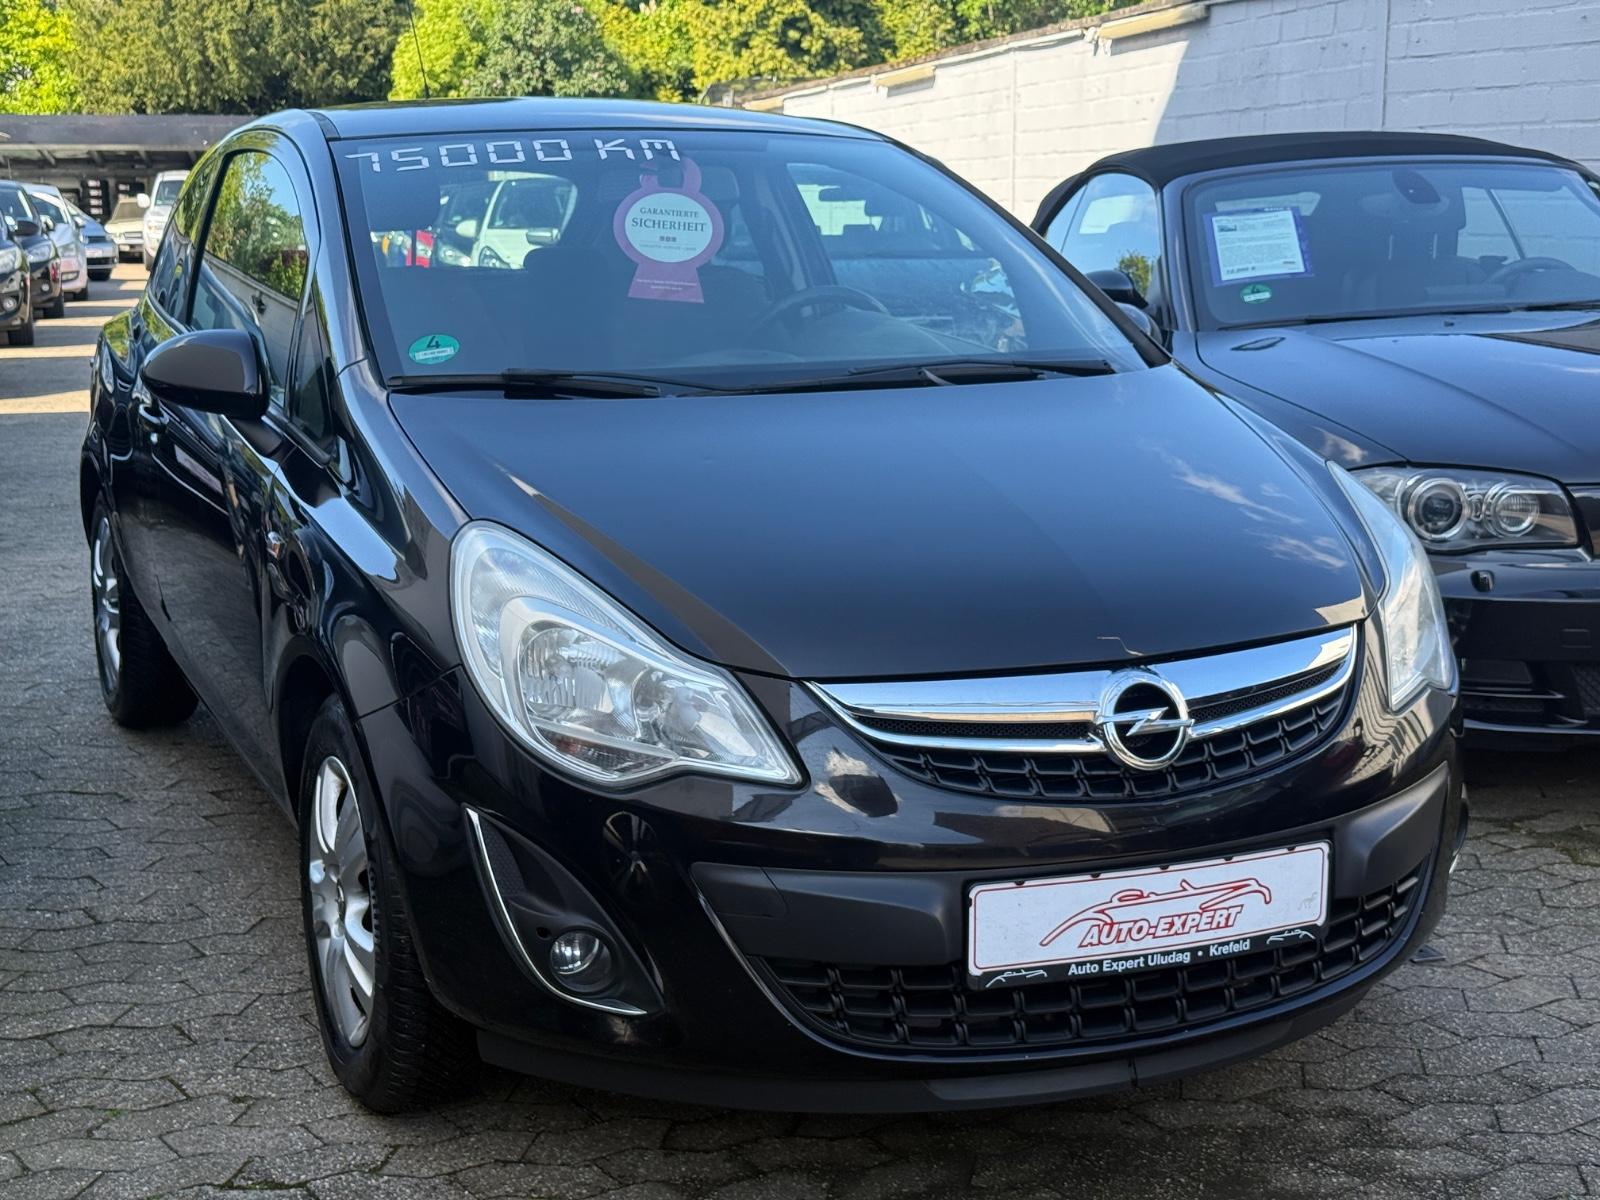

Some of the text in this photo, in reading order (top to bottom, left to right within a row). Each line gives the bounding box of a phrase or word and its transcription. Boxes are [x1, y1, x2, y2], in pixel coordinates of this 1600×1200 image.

[345, 138, 681, 172] 75000 KM
[632, 217, 707, 231] SICHERHEIT
[640, 207, 698, 218] GARANTIERTE
[426, 335, 441, 349] 4
[1078, 905, 1243, 947] AUTO-EXPERT
[1067, 939, 1251, 976] Auto Expert Uludag Krefeld
